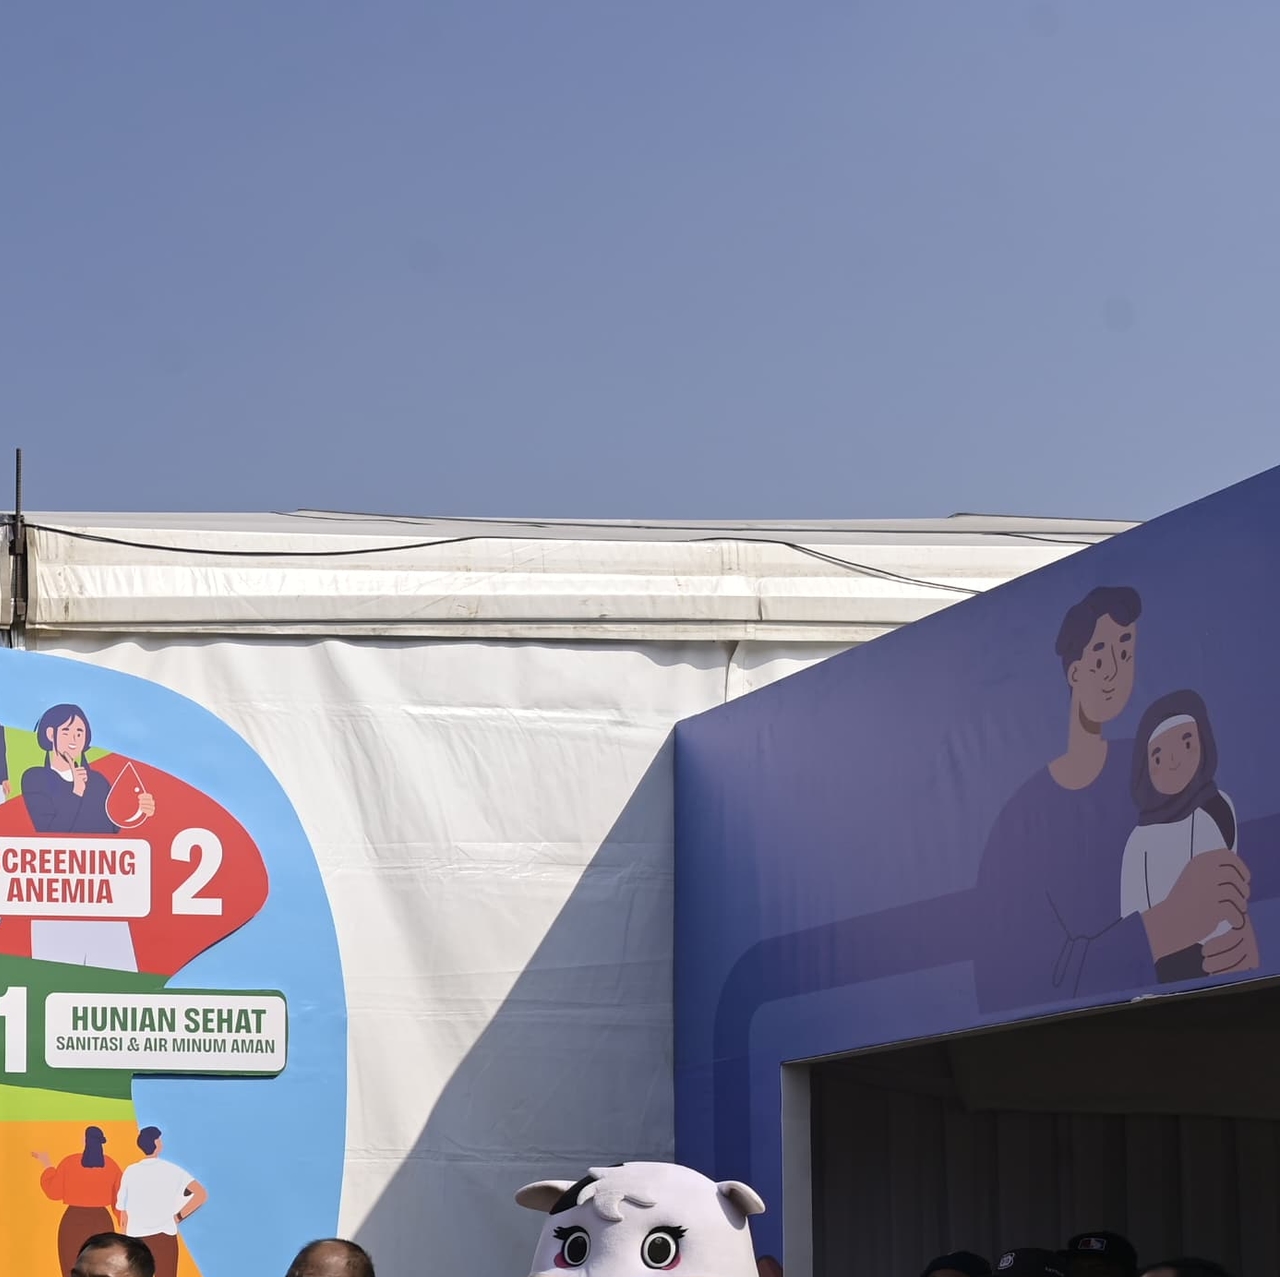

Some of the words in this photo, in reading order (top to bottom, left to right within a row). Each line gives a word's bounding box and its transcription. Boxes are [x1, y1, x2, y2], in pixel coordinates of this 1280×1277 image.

[171, 827, 223, 916] 2
[7, 875, 113, 905] ANEMIA
[71, 1006, 174, 1033] HUNIAN
[184, 1007, 266, 1033] SEHAT
[56, 1037, 124, 1052] SANITASI
[127, 1037, 141, 1052] &
[144, 1037, 168, 1052] AIR
[172, 1038, 227, 1053] MINUM
[231, 1038, 276, 1054] AMAN
